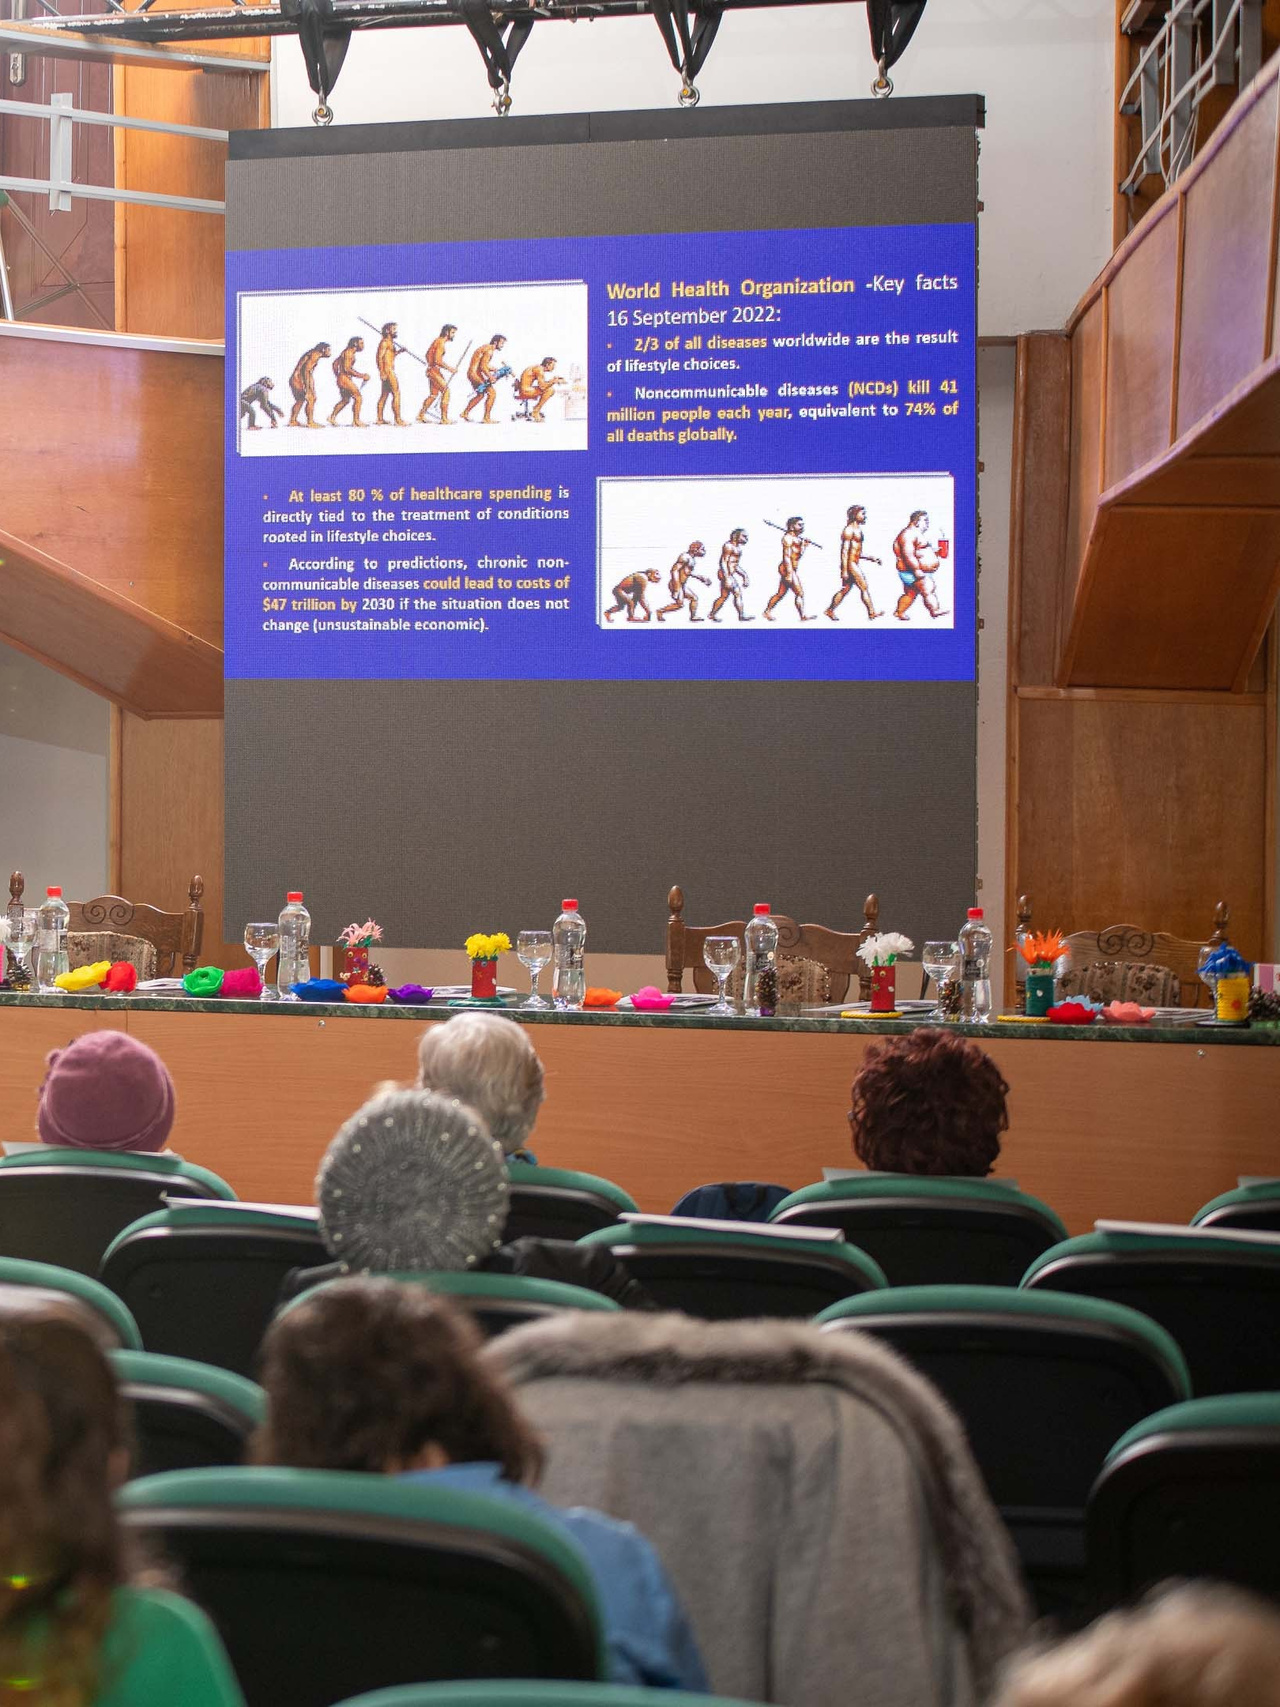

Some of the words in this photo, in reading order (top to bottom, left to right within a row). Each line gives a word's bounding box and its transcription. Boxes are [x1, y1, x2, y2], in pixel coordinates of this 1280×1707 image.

[607, 283, 660, 299] World
[672, 281, 729, 297] Health
[741, 278, 854, 299] Organization
[866, 276, 904, 295] -Key
[916, 274, 958, 290] facts
[608, 310, 628, 327] 16
[633, 307, 727, 327] September
[732, 306, 781, 324] 2022:
[635, 338, 659, 352] 2/3
[665, 337, 680, 350] of
[684, 336, 701, 350] all
[707, 336, 767, 349] diseases
[773, 333, 849, 347] worldwide
[856, 334, 879, 346] are
[885, 332, 909, 345] the
[916, 330, 958, 344] result
[607, 360, 622, 372] of
[625, 358, 680, 373] lifestyle
[684, 357, 740, 370] choices.
[635, 385, 768, 399] Noncommunicable
[778, 383, 838, 396] diseases
[849, 382, 898, 397] (NCDs)
[908, 381, 930, 394] kill
[940, 381, 957, 393] 41
[607, 408, 654, 421] million
[662, 406, 711, 422] people
[717, 405, 750, 419] each
[758, 406, 792, 421] year,
[799, 403, 876, 420] equivalent
[882, 404, 898, 416] to
[905, 402, 935, 415] 74%
[943, 401, 959, 414] of
[607, 430, 623, 442] all
[627, 429, 674, 442] deaths
[679, 428, 737, 443] globally.
[289, 490, 303, 502] At
[311, 489, 342, 502] least
[349, 490, 365, 501] 80
[371, 490, 383, 501] %
[390, 488, 405, 500] of
[411, 487, 482, 500] healthcare
[489, 487, 552, 502] spending
[558, 486, 569, 498] is
[263, 511, 312, 524] directly
[318, 511, 344, 522] tied
[352, 512, 365, 522] to
[372, 510, 394, 521] the
[401, 510, 470, 521] treatment
[477, 509, 492, 520] of
[497, 508, 569, 520] conditions
[263, 531, 306, 543] rooted
[311, 531, 323, 543] in
[327, 530, 378, 544] lifestyle
[382, 530, 436, 542] choices.
[289, 558, 354, 572] According
[363, 560, 378, 570] to
[388, 557, 467, 571] predictions,
[477, 557, 528, 568] chronic
[537, 558, 569, 568] non-
[263, 579, 359, 590] communicable
[363, 578, 419, 590] diseases
[423, 577, 460, 589] could
[464, 577, 494, 589] lead
[497, 578, 512, 588] to
[516, 578, 551, 588] costs
[555, 576, 570, 588] of
[263, 598, 286, 612] $47
[292, 598, 336, 611] trillion
[341, 598, 357, 613] by
[362, 599, 394, 610] 2030
[400, 598, 410, 610] if
[414, 597, 436, 609] the
[442, 597, 502, 610] situation
[508, 597, 540, 609] does
[545, 598, 569, 609] not
[263, 620, 309, 633] change
[313, 619, 410, 633] (unsustainable
[414, 618, 488, 632] economic).
